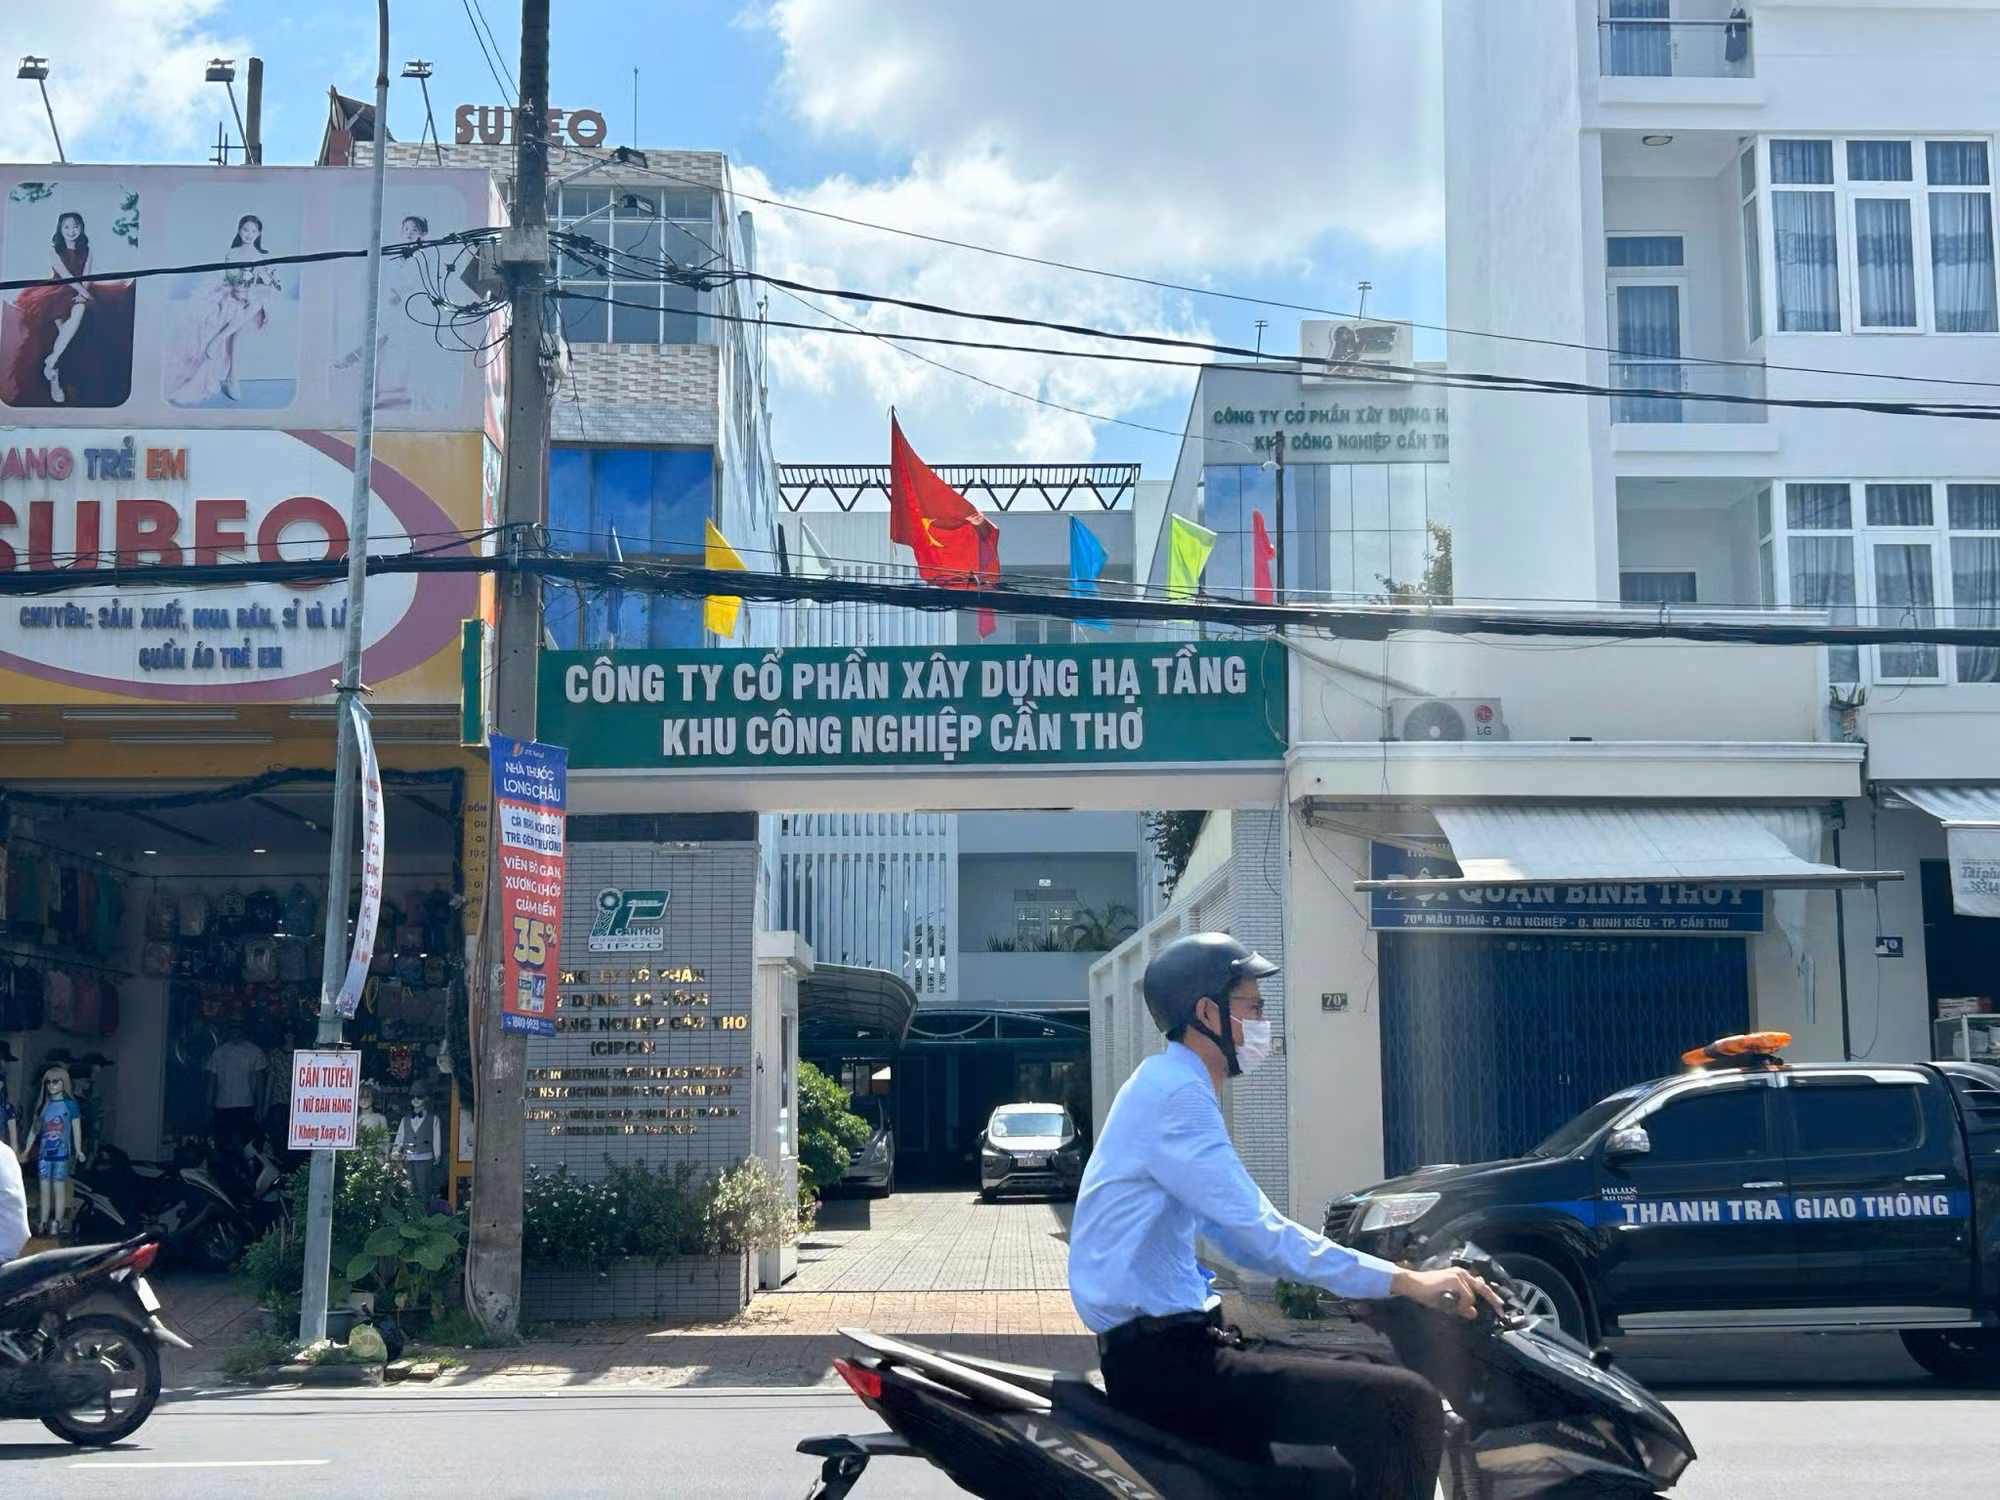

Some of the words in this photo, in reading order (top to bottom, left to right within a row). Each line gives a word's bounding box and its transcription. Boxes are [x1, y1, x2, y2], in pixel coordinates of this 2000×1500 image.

[456, 104, 607, 147] SUEO
[1213, 406, 1254, 425] CÔNG
[1259, 410, 1279, 424] TY
[1355, 405, 1383, 424] XÂY
[1436, 409, 1449, 424] H
[1292, 432, 1332, 450] CÔNG
[84, 436, 136, 480] TRẺ
[146, 448, 188, 481] EM
[98, 598, 133, 629] SẢN
[193, 608, 230, 629] MUA
[306, 601, 326, 629] VÀ
[220, 638, 251, 669] TRẺ
[258, 647, 282, 668] EM
[565, 656, 664, 703] CÔNG
[677, 664, 724, 701] TY
[733, 647, 784, 702] CỔ
[793, 647, 888, 700] PHẦN
[901, 652, 969, 699] XÂY
[981, 654, 1079, 705] DỰNG
[1092, 659, 1141, 704] HẠ
[1152, 644, 1246, 695] TẦNG
[663, 718, 736, 756] KHU
[746, 708, 842, 755] CÔNG
[852, 705, 982, 760] NGHIỆP
[990, 701, 1061, 752] CẦN
[1070, 706, 1143, 750] THƠ
[1477, 726, 1492, 736] LG
[505, 761, 525, 776] NHÀ
[1505, 917, 1522, 926] AN
[1592, 918, 1621, 928] NINH
[1601, 1187, 1638, 1195] HILUX
[1622, 1200, 1720, 1224] THANH
[1727, 1199, 1783, 1221] TRA
[1795, 1198, 1856, 1219] GIAO
[1862, 1193, 1949, 1217] THÔNG
